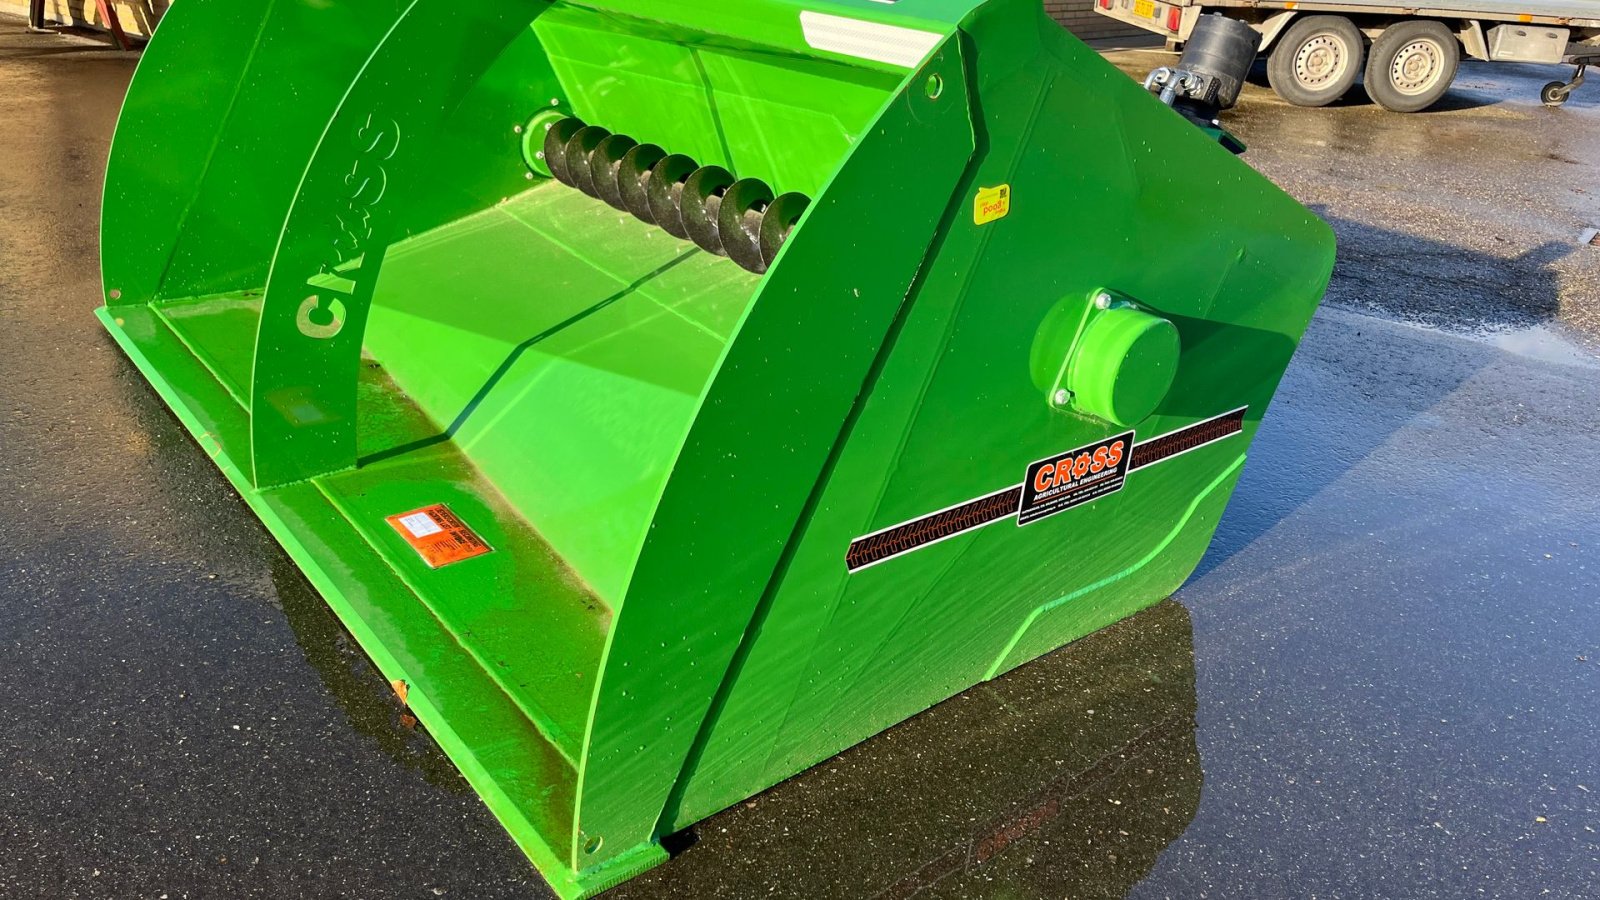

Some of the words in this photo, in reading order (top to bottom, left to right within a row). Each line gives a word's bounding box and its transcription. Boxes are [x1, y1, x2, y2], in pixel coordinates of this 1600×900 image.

[1033, 440, 1125, 493] CROSS
[1033, 481, 1079, 502] AGRICULTURAL
[1079, 467, 1118, 486] ENGINEERING
